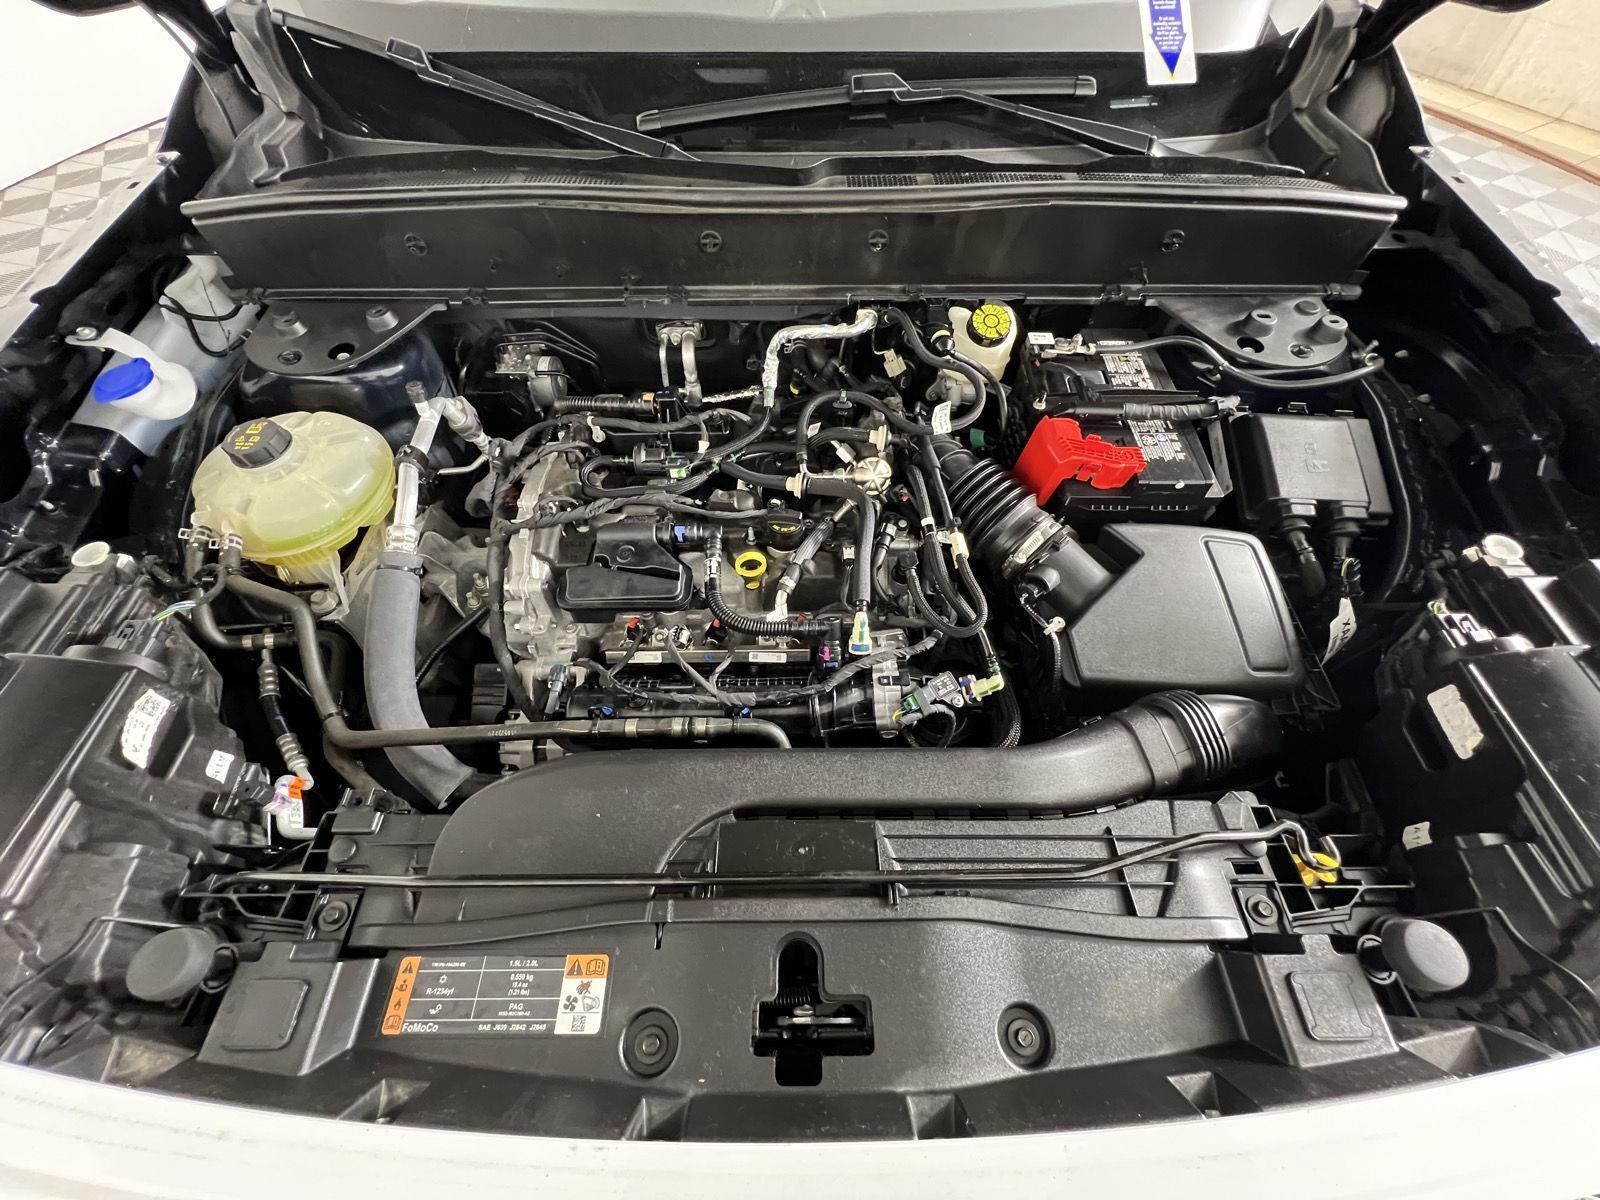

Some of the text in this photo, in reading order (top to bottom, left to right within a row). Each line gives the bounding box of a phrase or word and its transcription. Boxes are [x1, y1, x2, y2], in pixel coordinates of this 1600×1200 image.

[526, 973, 534, 982] kg
[426, 987, 455, 996] R-1234yf
[508, 1003, 523, 1011] PAG
[402, 1023, 439, 1032] FoMoCo
